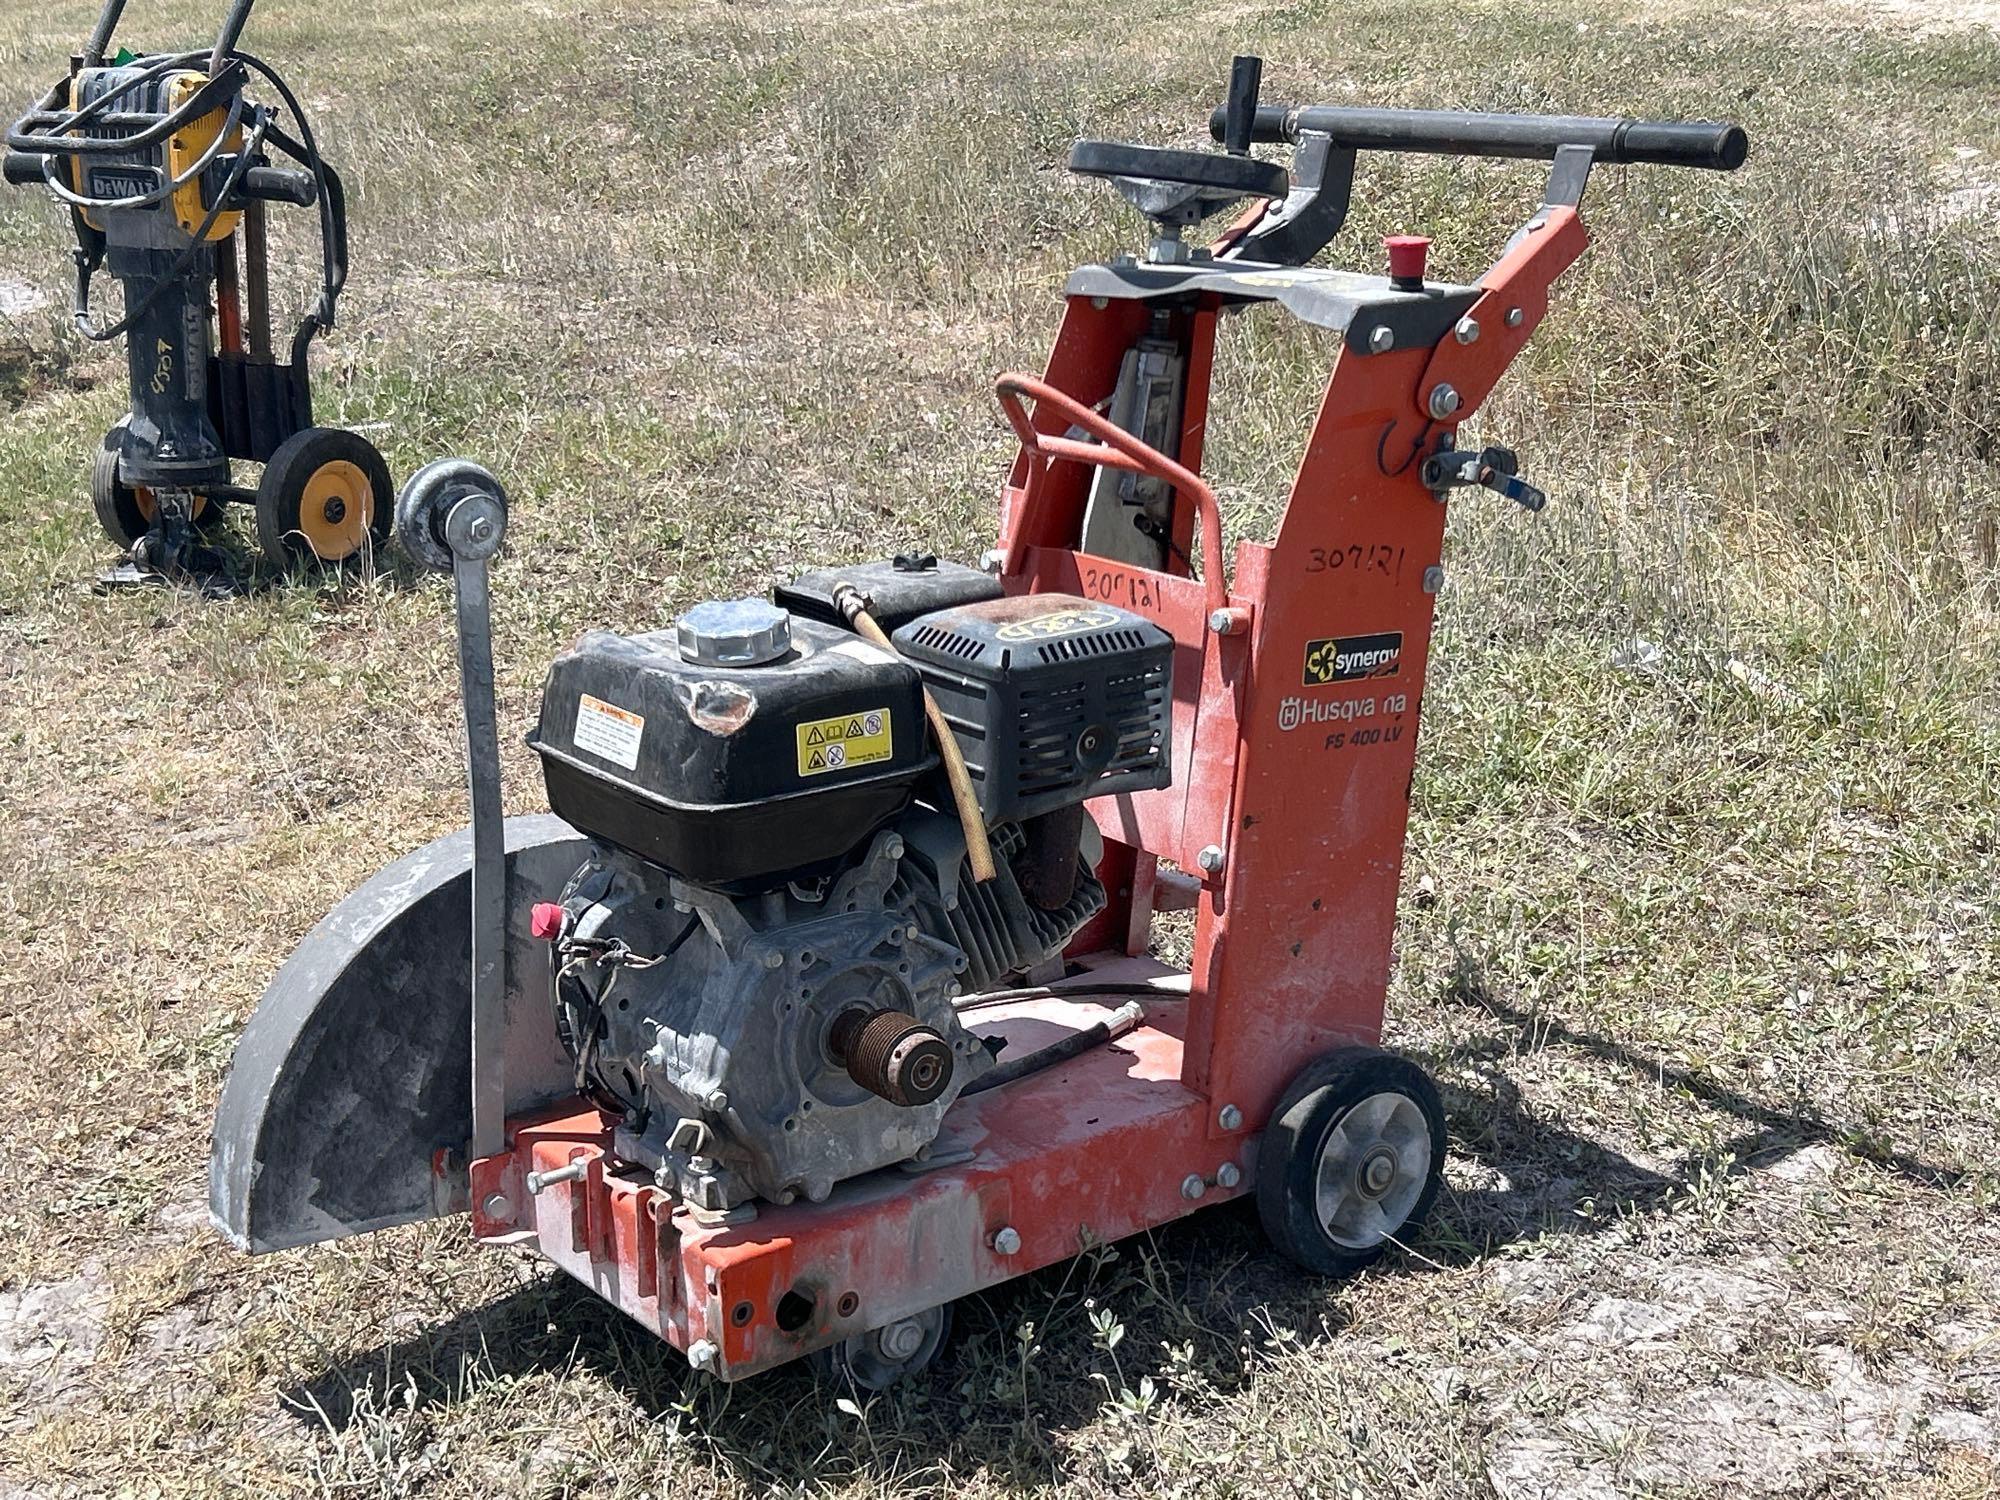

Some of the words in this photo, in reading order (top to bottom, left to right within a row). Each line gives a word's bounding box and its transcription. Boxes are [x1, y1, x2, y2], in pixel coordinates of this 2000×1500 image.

[1304, 544, 1405, 587] 307121
[1325, 733, 1345, 750] FS
[1349, 728, 1381, 747] 400
[1383, 726, 1404, 742] LV
